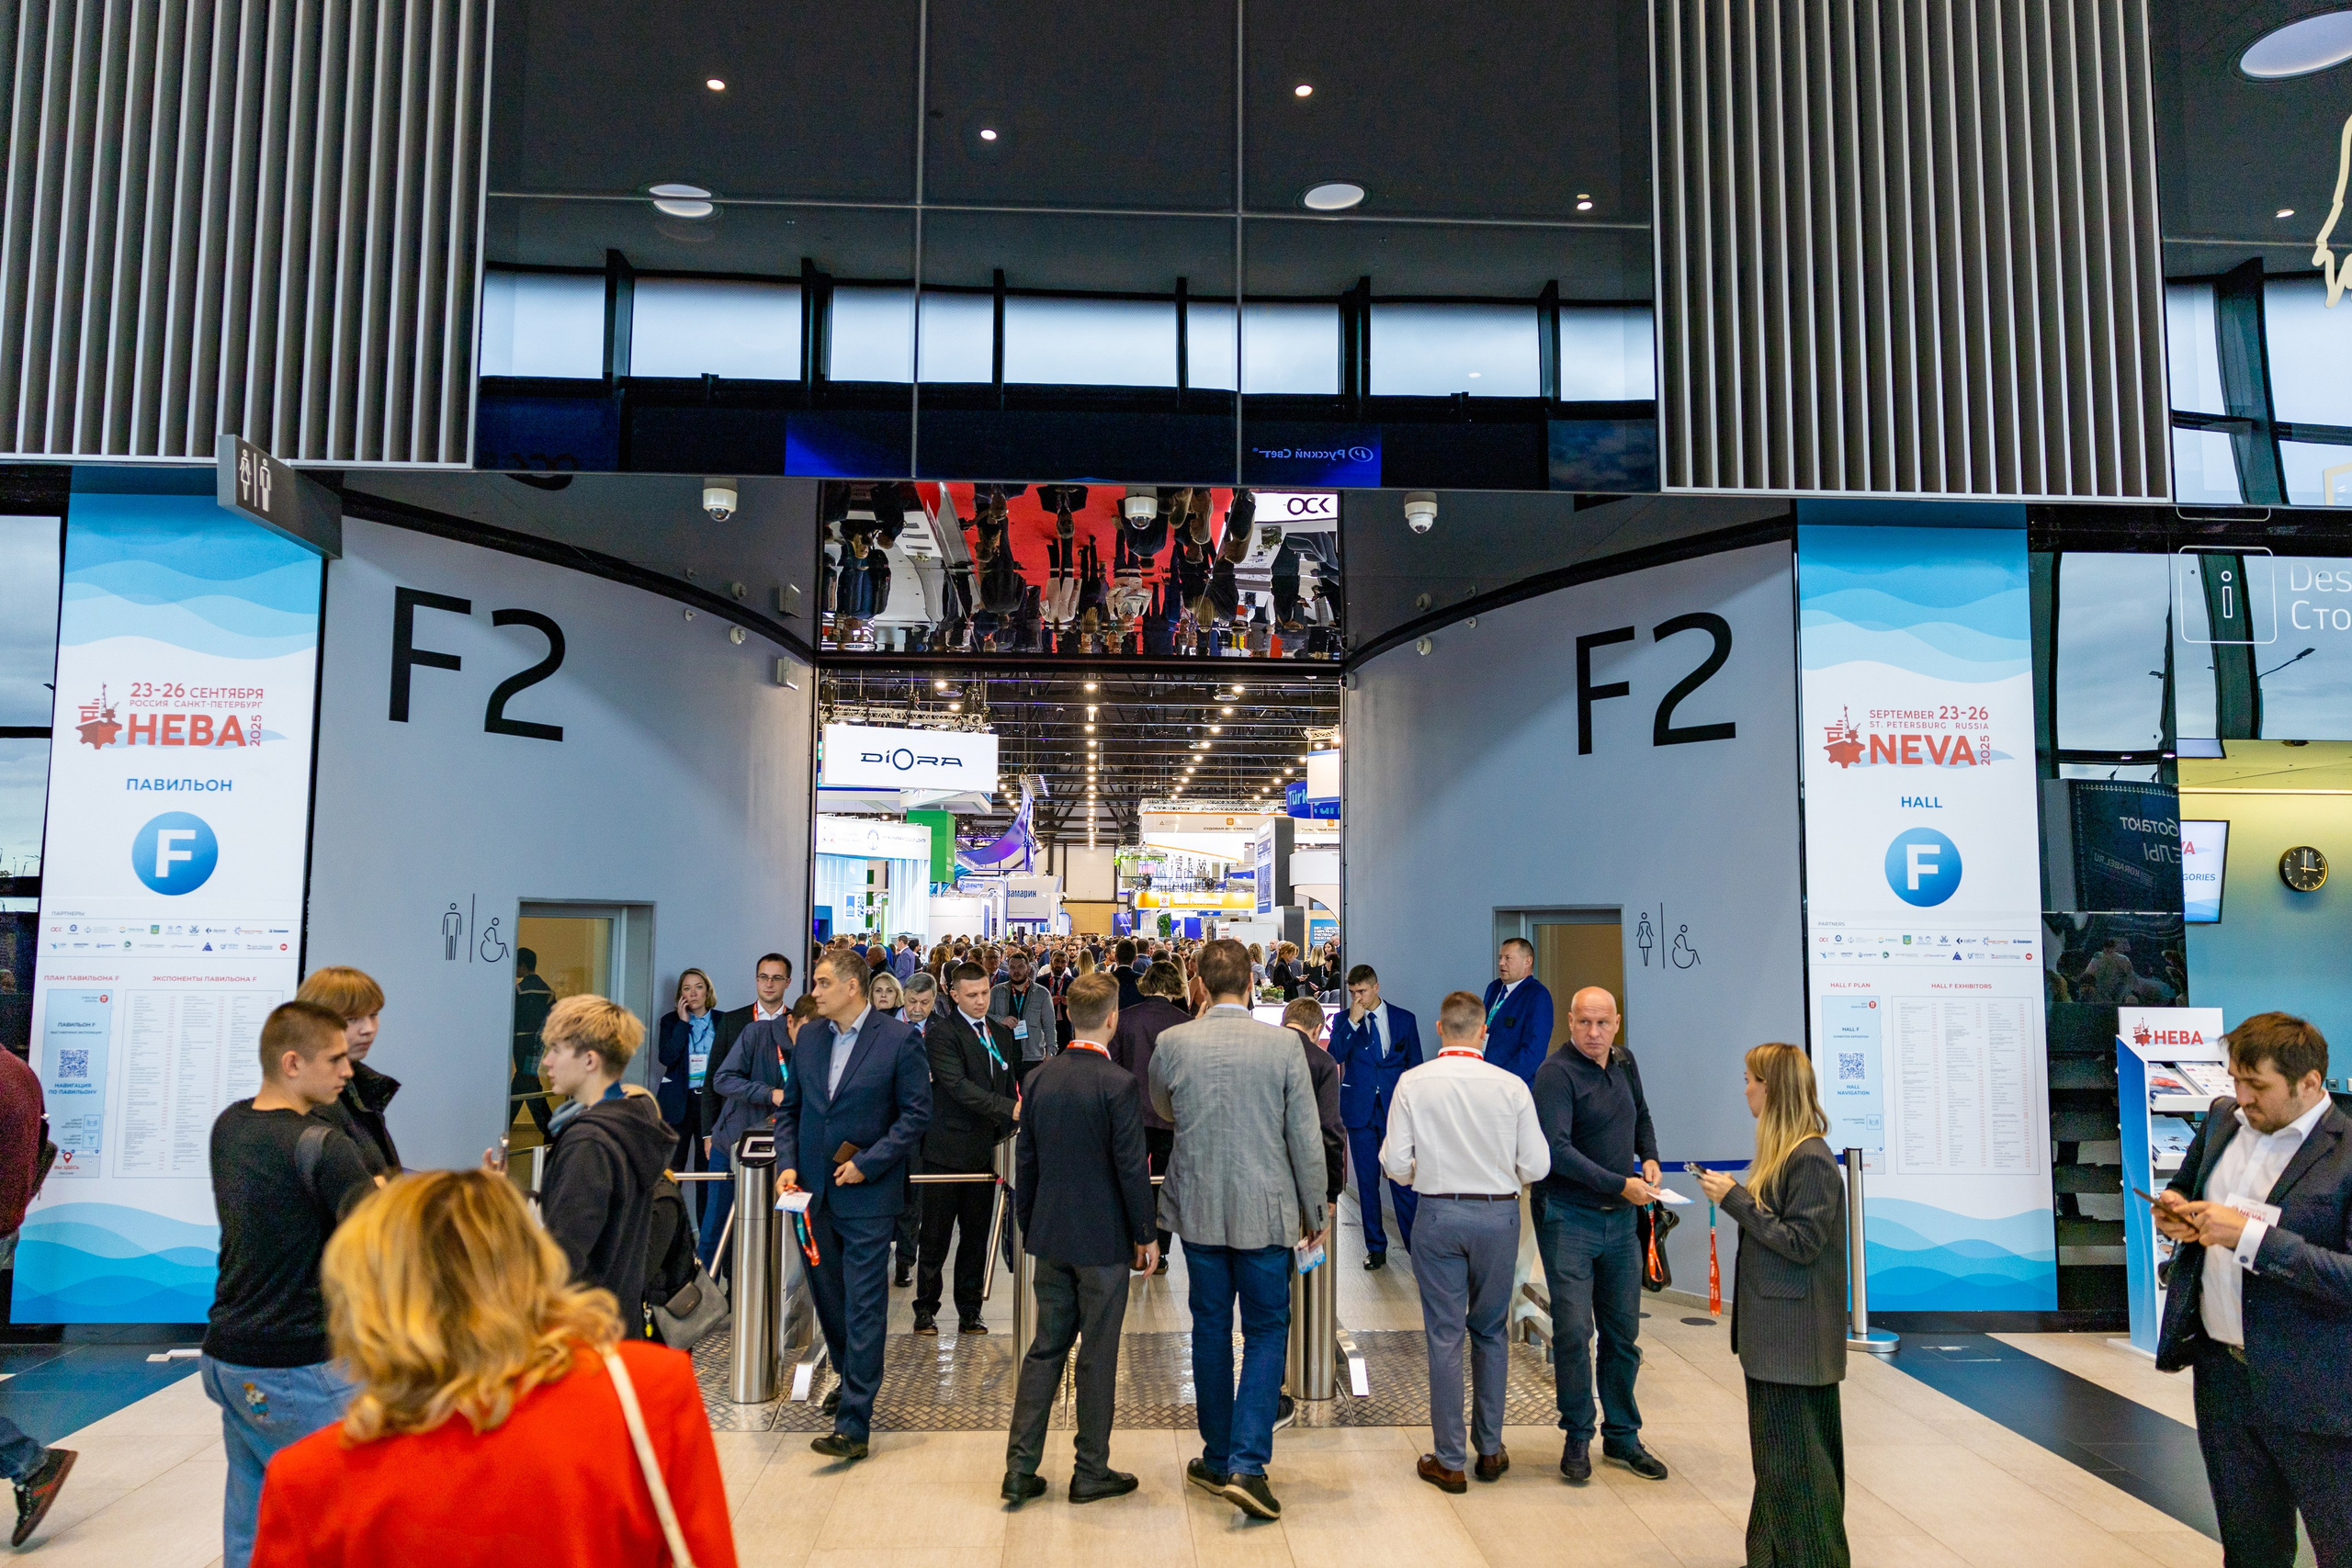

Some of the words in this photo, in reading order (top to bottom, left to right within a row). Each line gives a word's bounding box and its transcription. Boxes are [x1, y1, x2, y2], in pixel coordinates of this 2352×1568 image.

[389, 586, 566, 742] F2
[130, 682, 186, 698] 23-26
[189, 687, 264, 700] СЕНТЯБРЯ
[1576, 612, 1736, 755] F2
[129, 699, 168, 707] РОССИЯ
[173, 700, 263, 709] САНКТ-ПЕТЕРБУРГ
[1869, 709, 1935, 720] SEPTEMBER
[1939, 705, 1989, 720] 23-26
[127, 713, 246, 747] НЕВА
[250, 715, 262, 747] 2025
[1869, 720, 1883, 729] ST.
[1886, 720, 1946, 729] PETERSBURG
[1955, 721, 1989, 729] RUSSIA
[1869, 733, 1977, 766] NEVA
[1980, 735, 1991, 766] 2025
[127, 778, 233, 792] ПАВИЛЬОН
[1901, 795, 1943, 808] HALL
[155, 829, 197, 878] F
[1906, 843, 1940, 891] F
[2154, 1030, 2203, 1045] НЕВА
